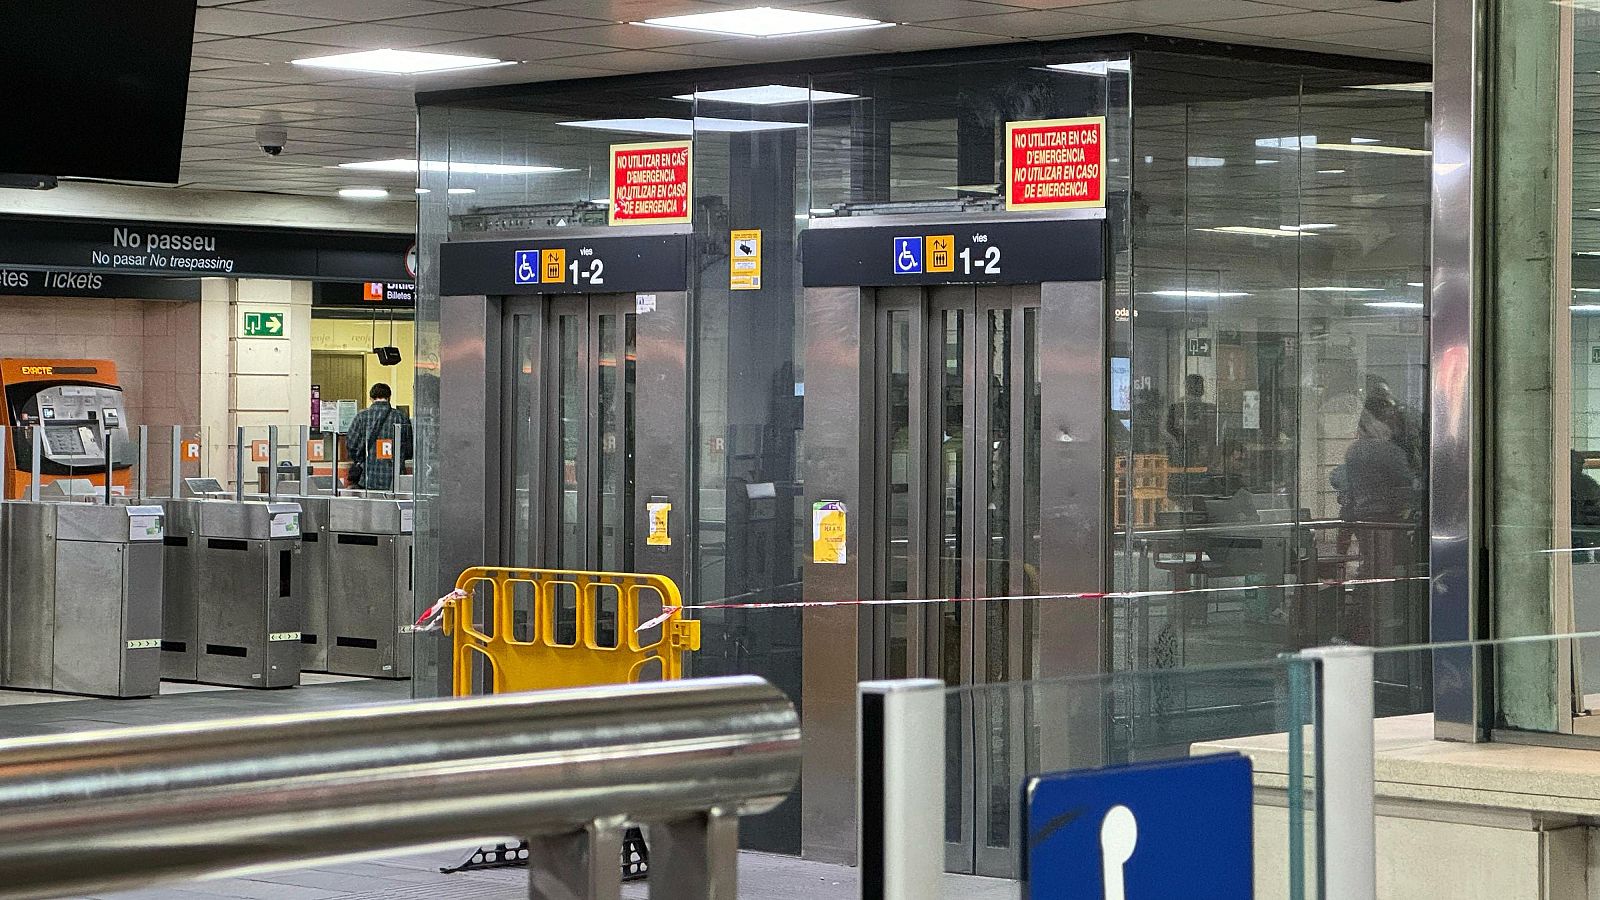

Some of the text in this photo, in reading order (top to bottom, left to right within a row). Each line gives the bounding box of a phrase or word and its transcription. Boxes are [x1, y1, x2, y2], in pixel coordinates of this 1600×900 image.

[1015, 130, 1097, 148] NO UTILITZAR EN CAS
[617, 152, 686, 168] NO UTILITZAR EN CAS
[1027, 145, 1085, 164] D'EMERGÈNCIA
[627, 166, 675, 184] D'EMERGÈNCIA
[1014, 164, 1098, 182] NO UTILIZAR EN CASO
[616, 182, 686, 199] NO UTILIZAR EN CASO
[1024, 181, 1088, 198] DE EMERGENCIA
[624, 199, 677, 214] DE EMERGENCIA
[113, 228, 216, 252] No passeu
[972, 232, 988, 242] vies
[580, 247, 593, 256] vies
[960, 246, 1000, 274] 1-2
[92, 251, 234, 272] No pasar No trespassing
[44, 271, 103, 289] Tickets
[569, 259, 604, 284] 1-2
[387, 291, 411, 299] Billetes
[22, 366, 53, 375] EXACTE
[188, 444, 199, 457] R
[259, 444, 268, 457] R
[314, 444, 324, 456] R
[382, 443, 392, 456] R
